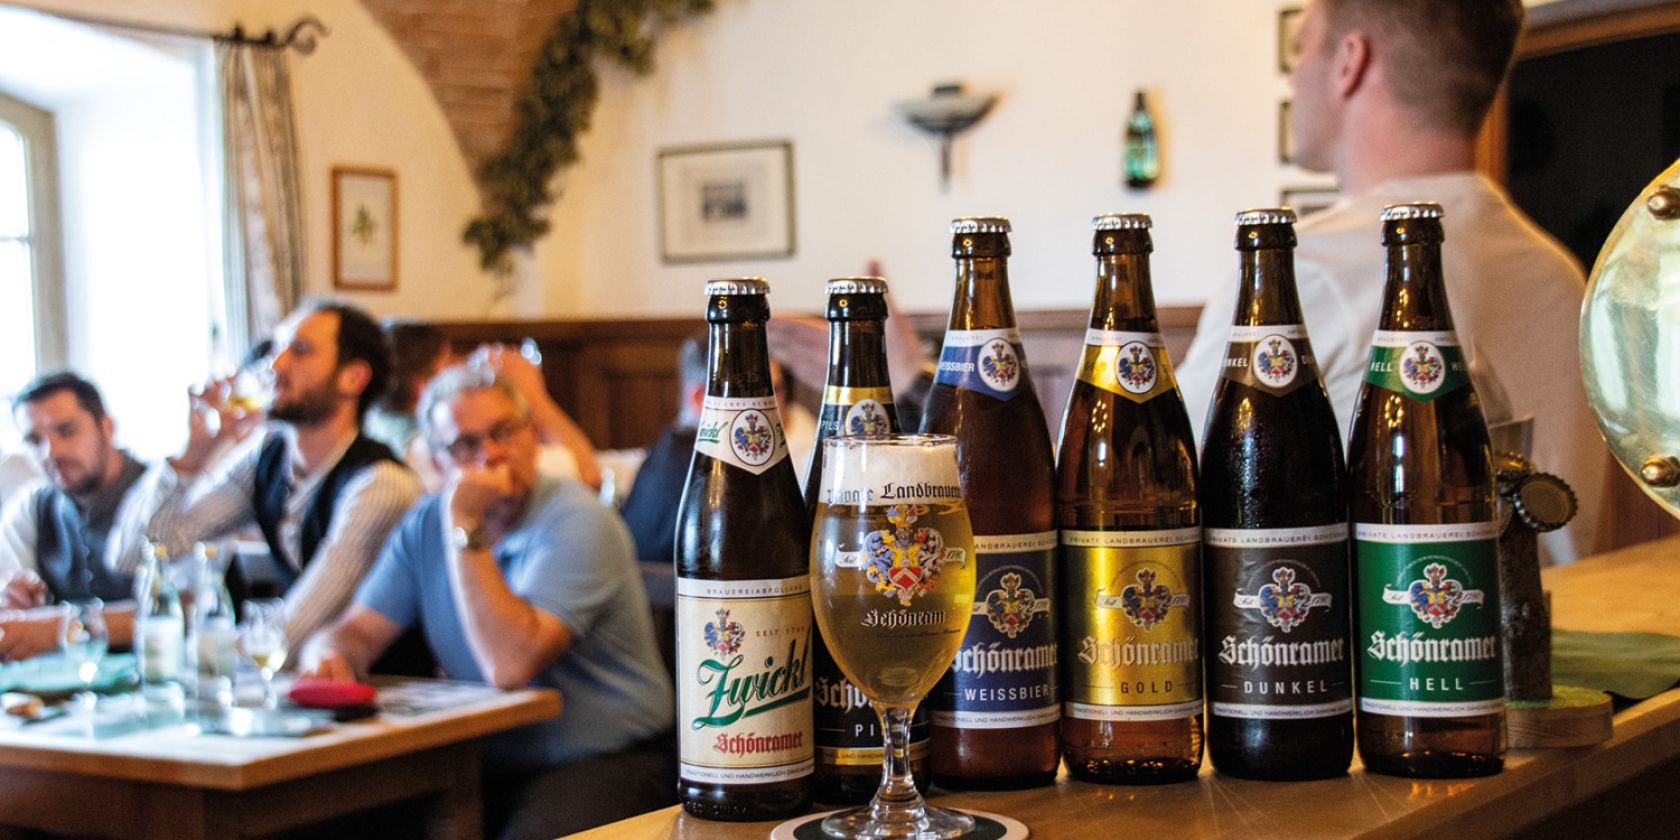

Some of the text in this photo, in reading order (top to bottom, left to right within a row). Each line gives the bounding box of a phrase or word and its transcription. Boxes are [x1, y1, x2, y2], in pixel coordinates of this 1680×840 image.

[1104, 537, 1173, 545] LANDBRAUEREI
[1240, 535, 1311, 543] LANDBRAUEREI
[1357, 531, 1387, 539] PRIVATE
[1391, 532, 1463, 540] LANDBRAUEREI
[975, 541, 1036, 550] ANDBRAUEREI
[861, 609, 945, 629] Schönram
[756, 629, 779, 638] SEIT
[1078, 635, 1198, 673] Schönramer
[1218, 635, 1344, 672] Schönramer
[1366, 630, 1496, 667] Schönramer
[692, 627, 811, 730] Zwickl
[1409, 677, 1463, 691] HELL
[965, 684, 1049, 701] WEISSBIER
[1120, 680, 1173, 694] GOLD
[1244, 680, 1328, 695] DUNKEL
[855, 723, 875, 737] PI
[712, 731, 803, 758] Schönramer
